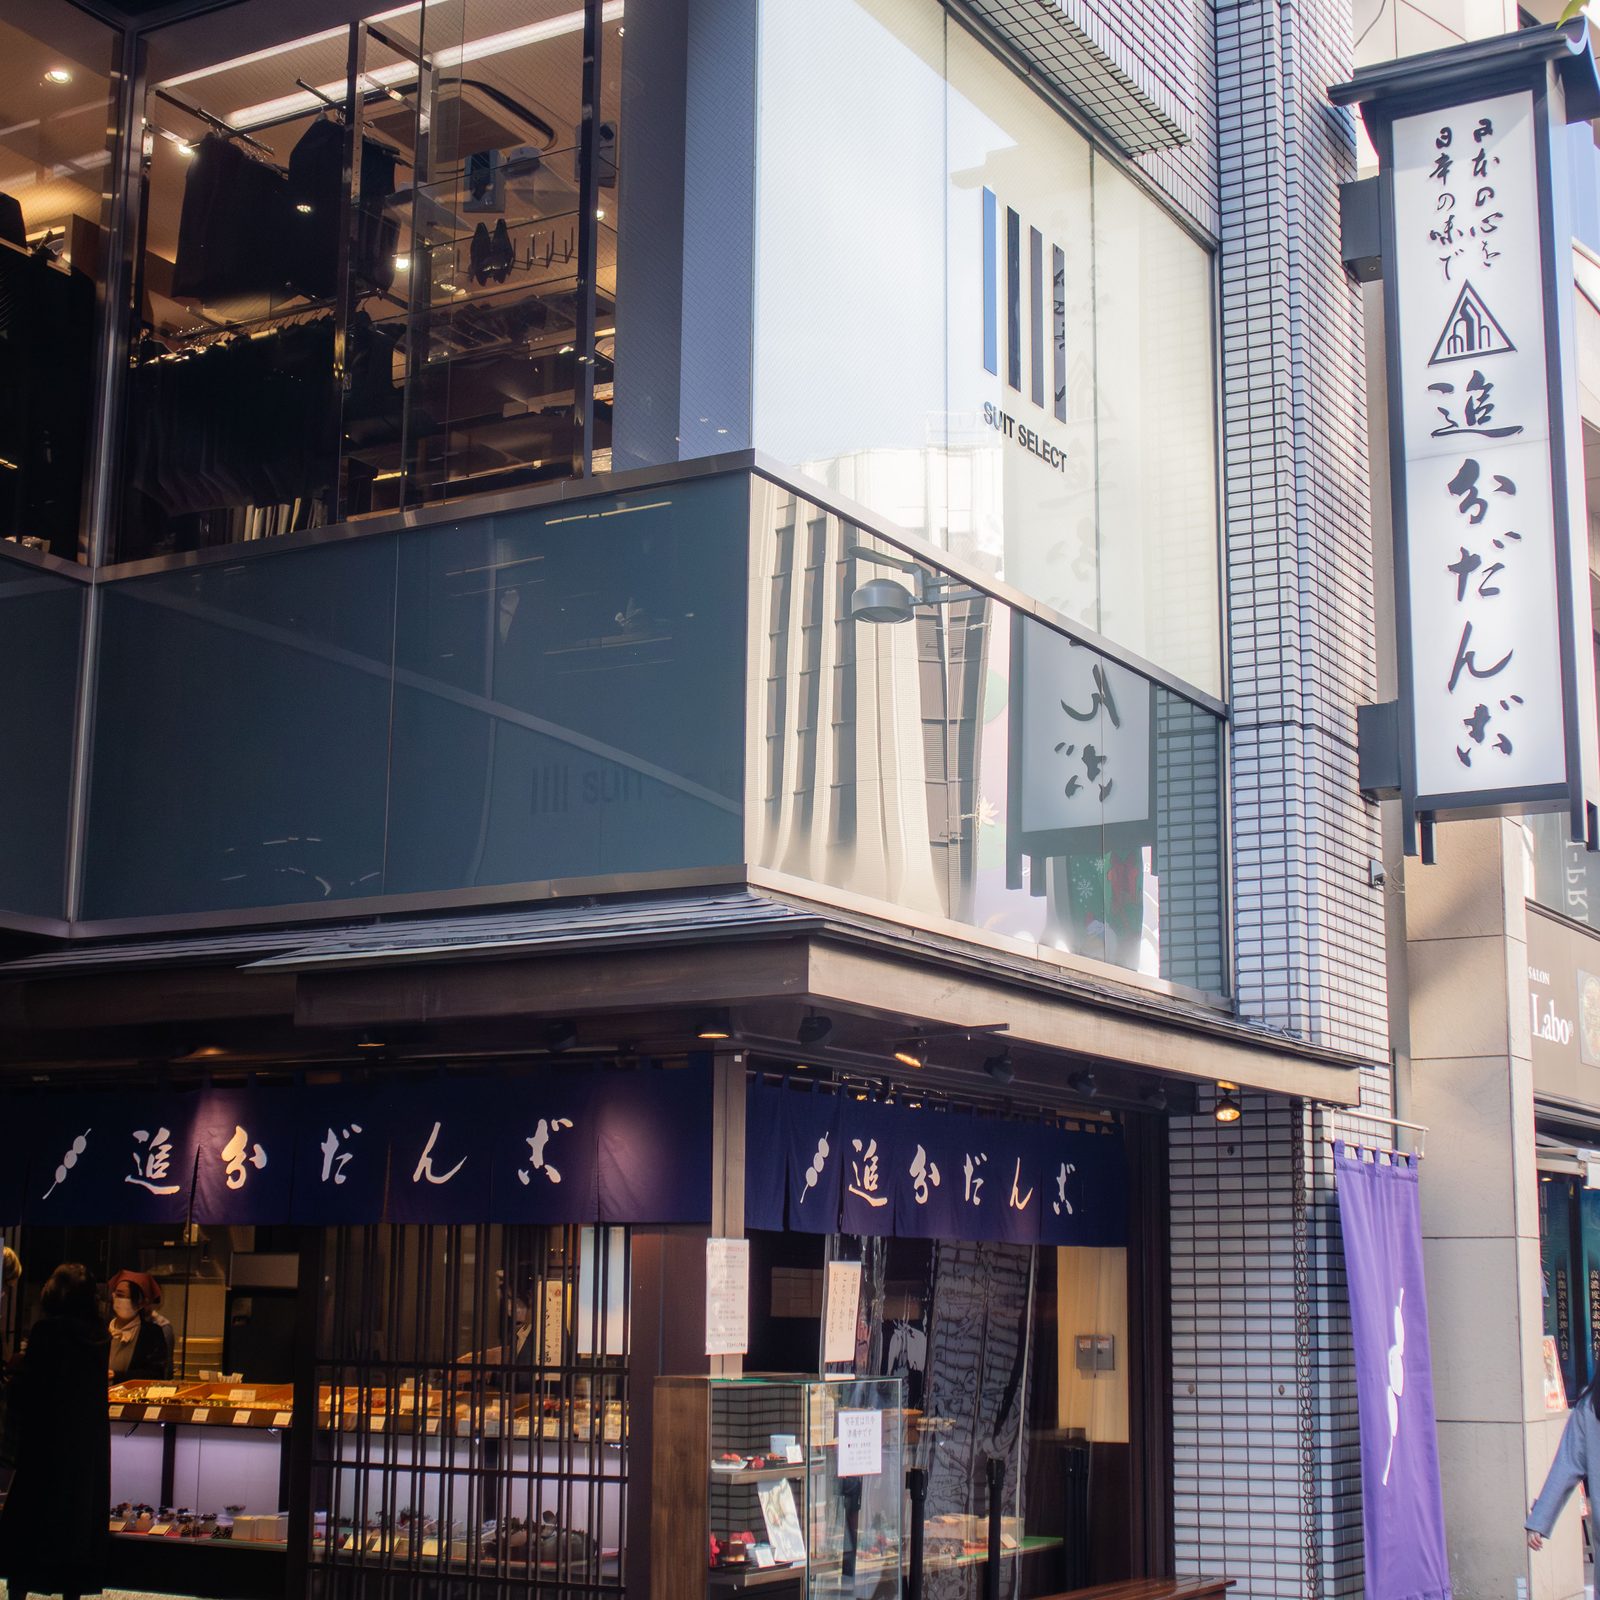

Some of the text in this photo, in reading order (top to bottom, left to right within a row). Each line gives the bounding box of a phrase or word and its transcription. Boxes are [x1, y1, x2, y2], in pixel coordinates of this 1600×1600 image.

[983, 401, 1067, 473] SUIT SELECT
[1528, 966, 1550, 985] SALON
[1531, 993, 1569, 1045] Labo
